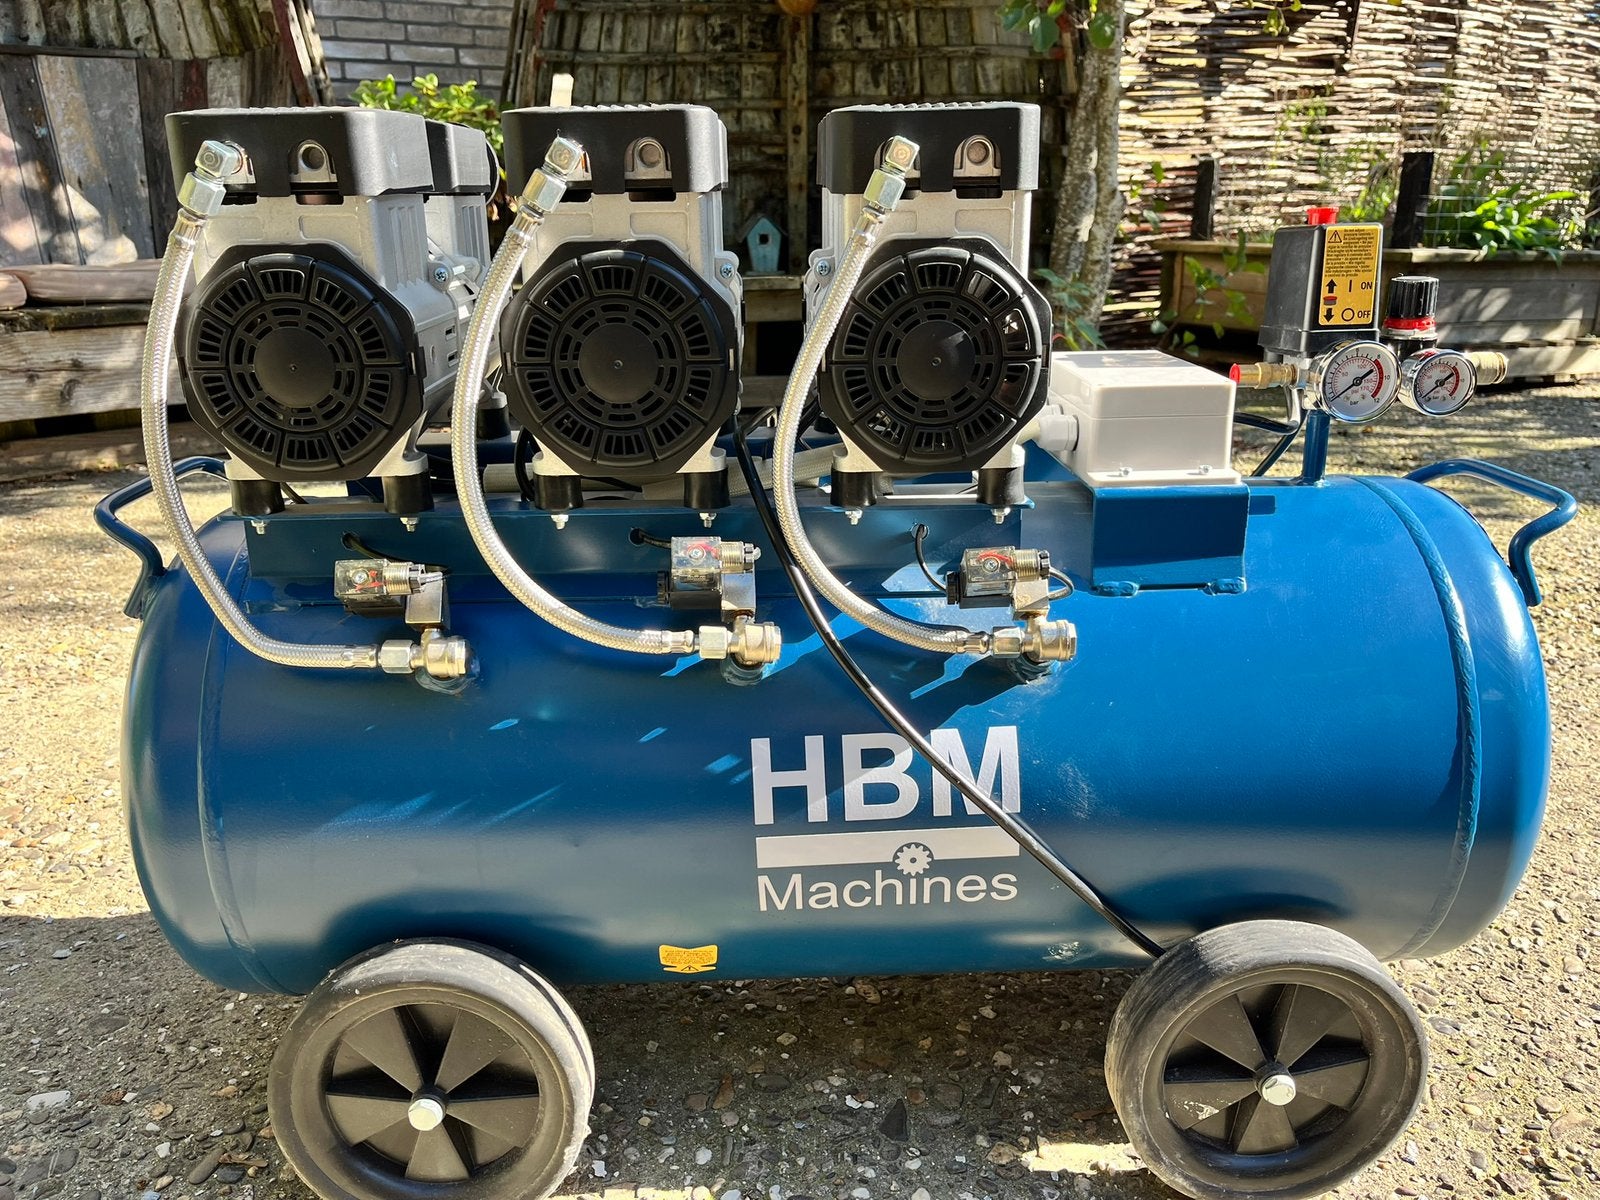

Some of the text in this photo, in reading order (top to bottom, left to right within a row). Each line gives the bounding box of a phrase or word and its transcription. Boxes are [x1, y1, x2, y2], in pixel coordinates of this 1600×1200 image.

[1361, 282, 1372, 290] ON
[1358, 310, 1370, 318] OFF
[751, 725, 1020, 825] HBM
[757, 869, 1018, 912] Machines
